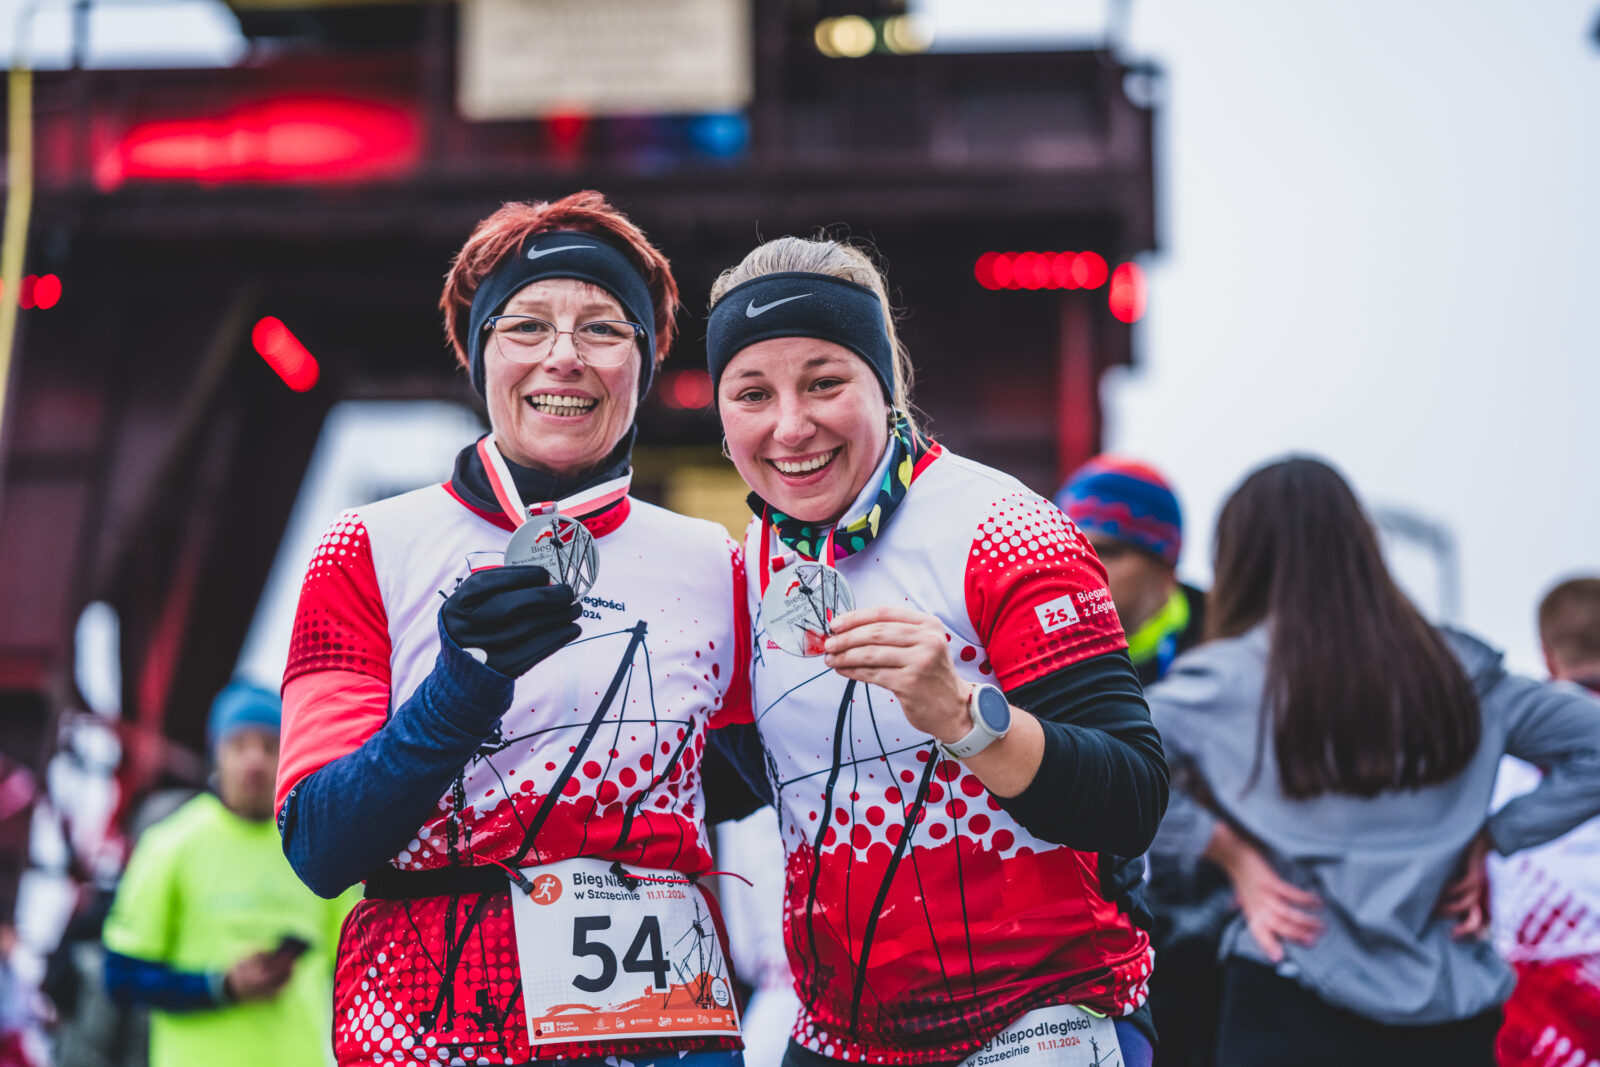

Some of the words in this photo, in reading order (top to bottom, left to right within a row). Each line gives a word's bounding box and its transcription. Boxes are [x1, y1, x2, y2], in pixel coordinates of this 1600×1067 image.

[531, 544, 552, 553] Bieg
[581, 596, 626, 611] egłości
[583, 609, 602, 620] 024
[1083, 608, 1091, 617] z
[573, 871, 603, 888] Bieg
[574, 891, 584, 900] w
[587, 889, 641, 901] Szczecinie
[646, 889, 686, 900] 11.11.2024
[572, 915, 671, 993] 54
[996, 1016, 1092, 1046] Niepodległości
[966, 1059, 976, 1067] w
[977, 1044, 1030, 1066] Szczecinie
[1037, 1036, 1081, 1051] 11.11.2024
